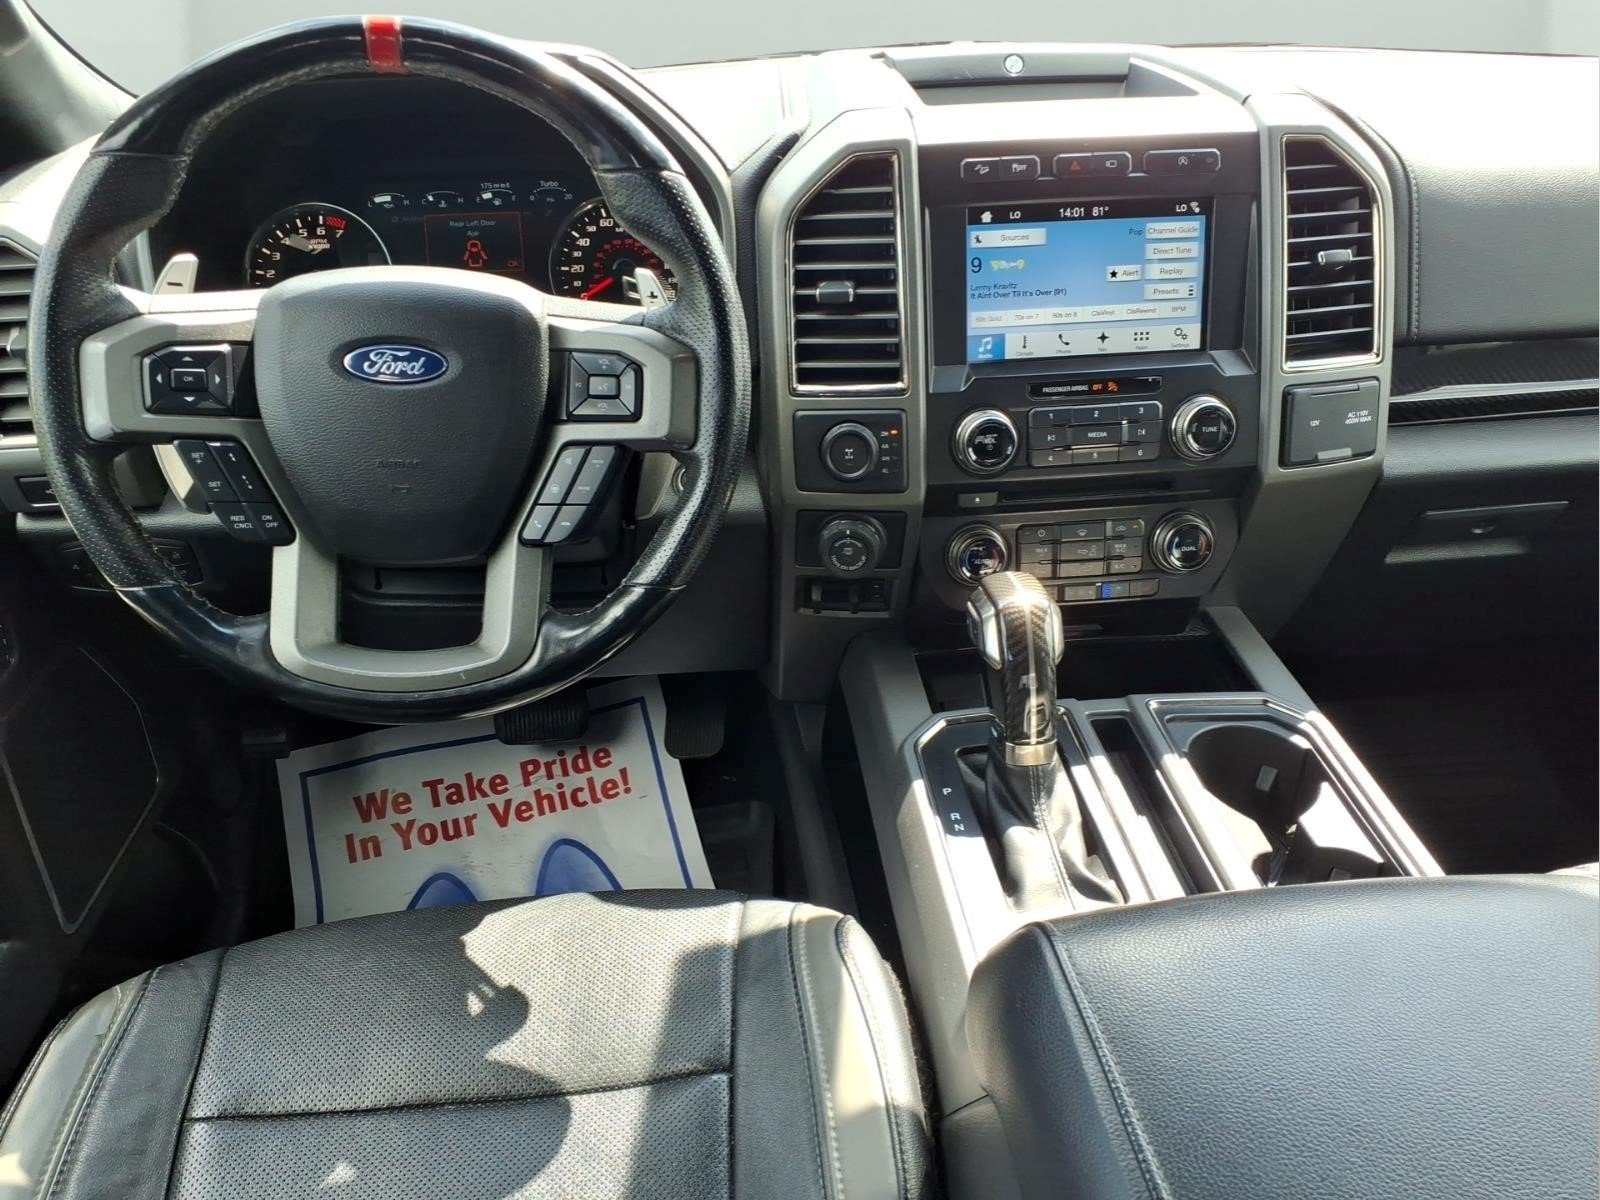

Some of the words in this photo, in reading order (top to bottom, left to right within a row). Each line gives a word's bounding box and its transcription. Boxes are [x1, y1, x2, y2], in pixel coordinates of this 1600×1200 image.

[1059, 207, 1085, 218] 14:01
[1092, 206, 1109, 217] 81°
[1176, 204, 1188, 212] LO
[1009, 211, 1022, 219] LO
[600, 218, 614, 227] 60
[299, 229, 308, 238] 5
[316, 227, 326, 236] 6
[335, 229, 345, 239] 7
[1129, 228, 1143, 237] Pop
[1147, 227, 1177, 235] Channel
[1178, 225, 1199, 234] Guide
[281, 237, 290, 245] 4
[1000, 233, 1030, 242] Sources
[576, 238, 590, 247] 40
[1153, 247, 1174, 255] Direct
[1176, 246, 1193, 254] Tune
[271, 252, 281, 261] 3
[570, 264, 585, 273] 20
[970, 256, 983, 273] 9
[265, 269, 276, 278] 2
[1122, 268, 1139, 276] Alert
[1160, 267, 1184, 276] Replay
[993, 282, 1018, 290] Kravitz
[993, 291, 1011, 299] Over
[1035, 289, 1052, 297] Over
[1053, 288, 1067, 296] (91)
[1153, 287, 1180, 296] Presets
[363, 349, 427, 375] Ford
[1043, 385, 1070, 393] PASSENGER
[1071, 384, 1089, 392] AIRBAG
[1093, 410, 1099, 418] 2
[1138, 406, 1144, 414] 3
[1138, 449, 1143, 457] 6
[353, 788, 413, 824] We
[422, 772, 509, 809] Take
[519, 744, 613, 787] Pride
[942, 787, 952, 795] P
[345, 833, 383, 864] In
[390, 812, 478, 851] Your
[487, 767, 632, 829] Vehicle!
[950, 812, 961, 821] R
